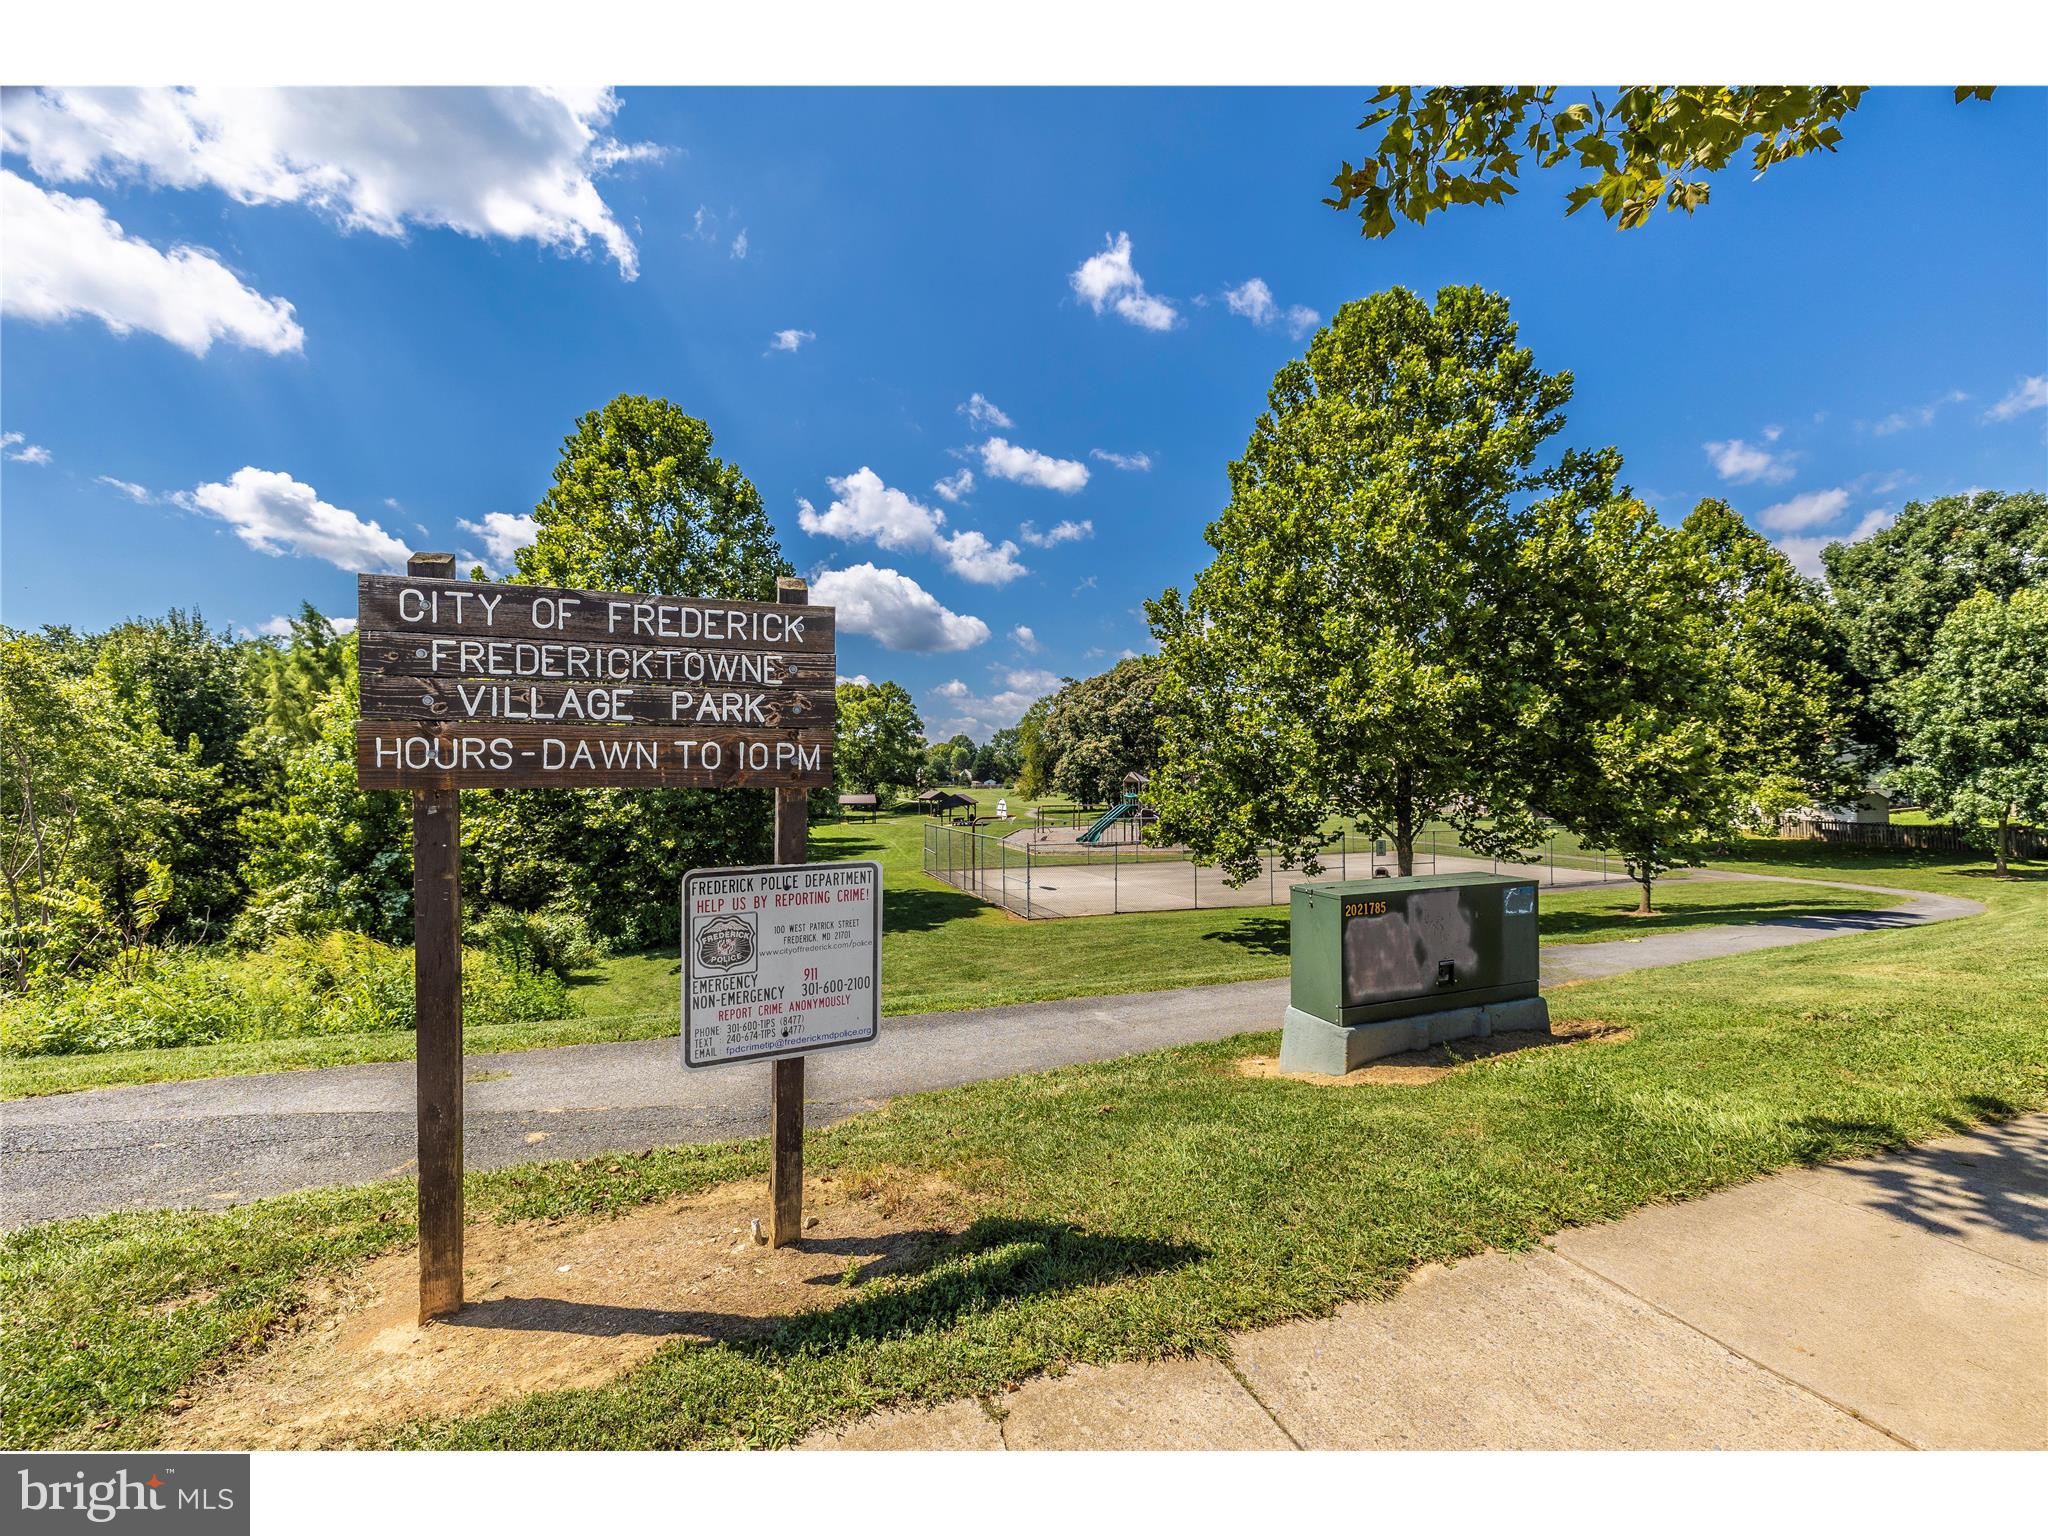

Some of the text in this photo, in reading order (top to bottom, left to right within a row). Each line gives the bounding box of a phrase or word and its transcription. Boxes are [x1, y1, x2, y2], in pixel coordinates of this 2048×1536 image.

[399, 588, 804, 643] CITY OF FREDERICK
[432, 640, 783, 684] FREDERICKTOWNE
[457, 684, 766, 723] VILLAGE PARK
[674, 741, 721, 770] TO
[692, 870, 872, 896] FREDERICK POLICE DEPARTMENT
[697, 888, 869, 913] HELP US BY REPORTING CRIME!
[1345, 901, 1387, 917] 2021785
[701, 930, 750, 945] FREDERICK
[774, 919, 860, 934] 100 WEST PATRICK STREET
[822, 932, 831, 941] MD
[834, 930, 851, 940] 21701
[710, 952, 742, 963] POLICE
[692, 968, 818, 995] EMERGENCY 911
[692, 976, 871, 1011] NON-EMERGENCY 301-600-2100
[718, 994, 851, 1022] REPORT CRIME ANONYMOUSLY
[726, 1028, 776, 1045] 240-674-TIPS
[727, 1018, 775, 1034] 301-600-TIPS
[780, 1014, 805, 1026] (8477)
[726, 1027, 872, 1055] fpdcrimetip@frederickmdpolice.org
